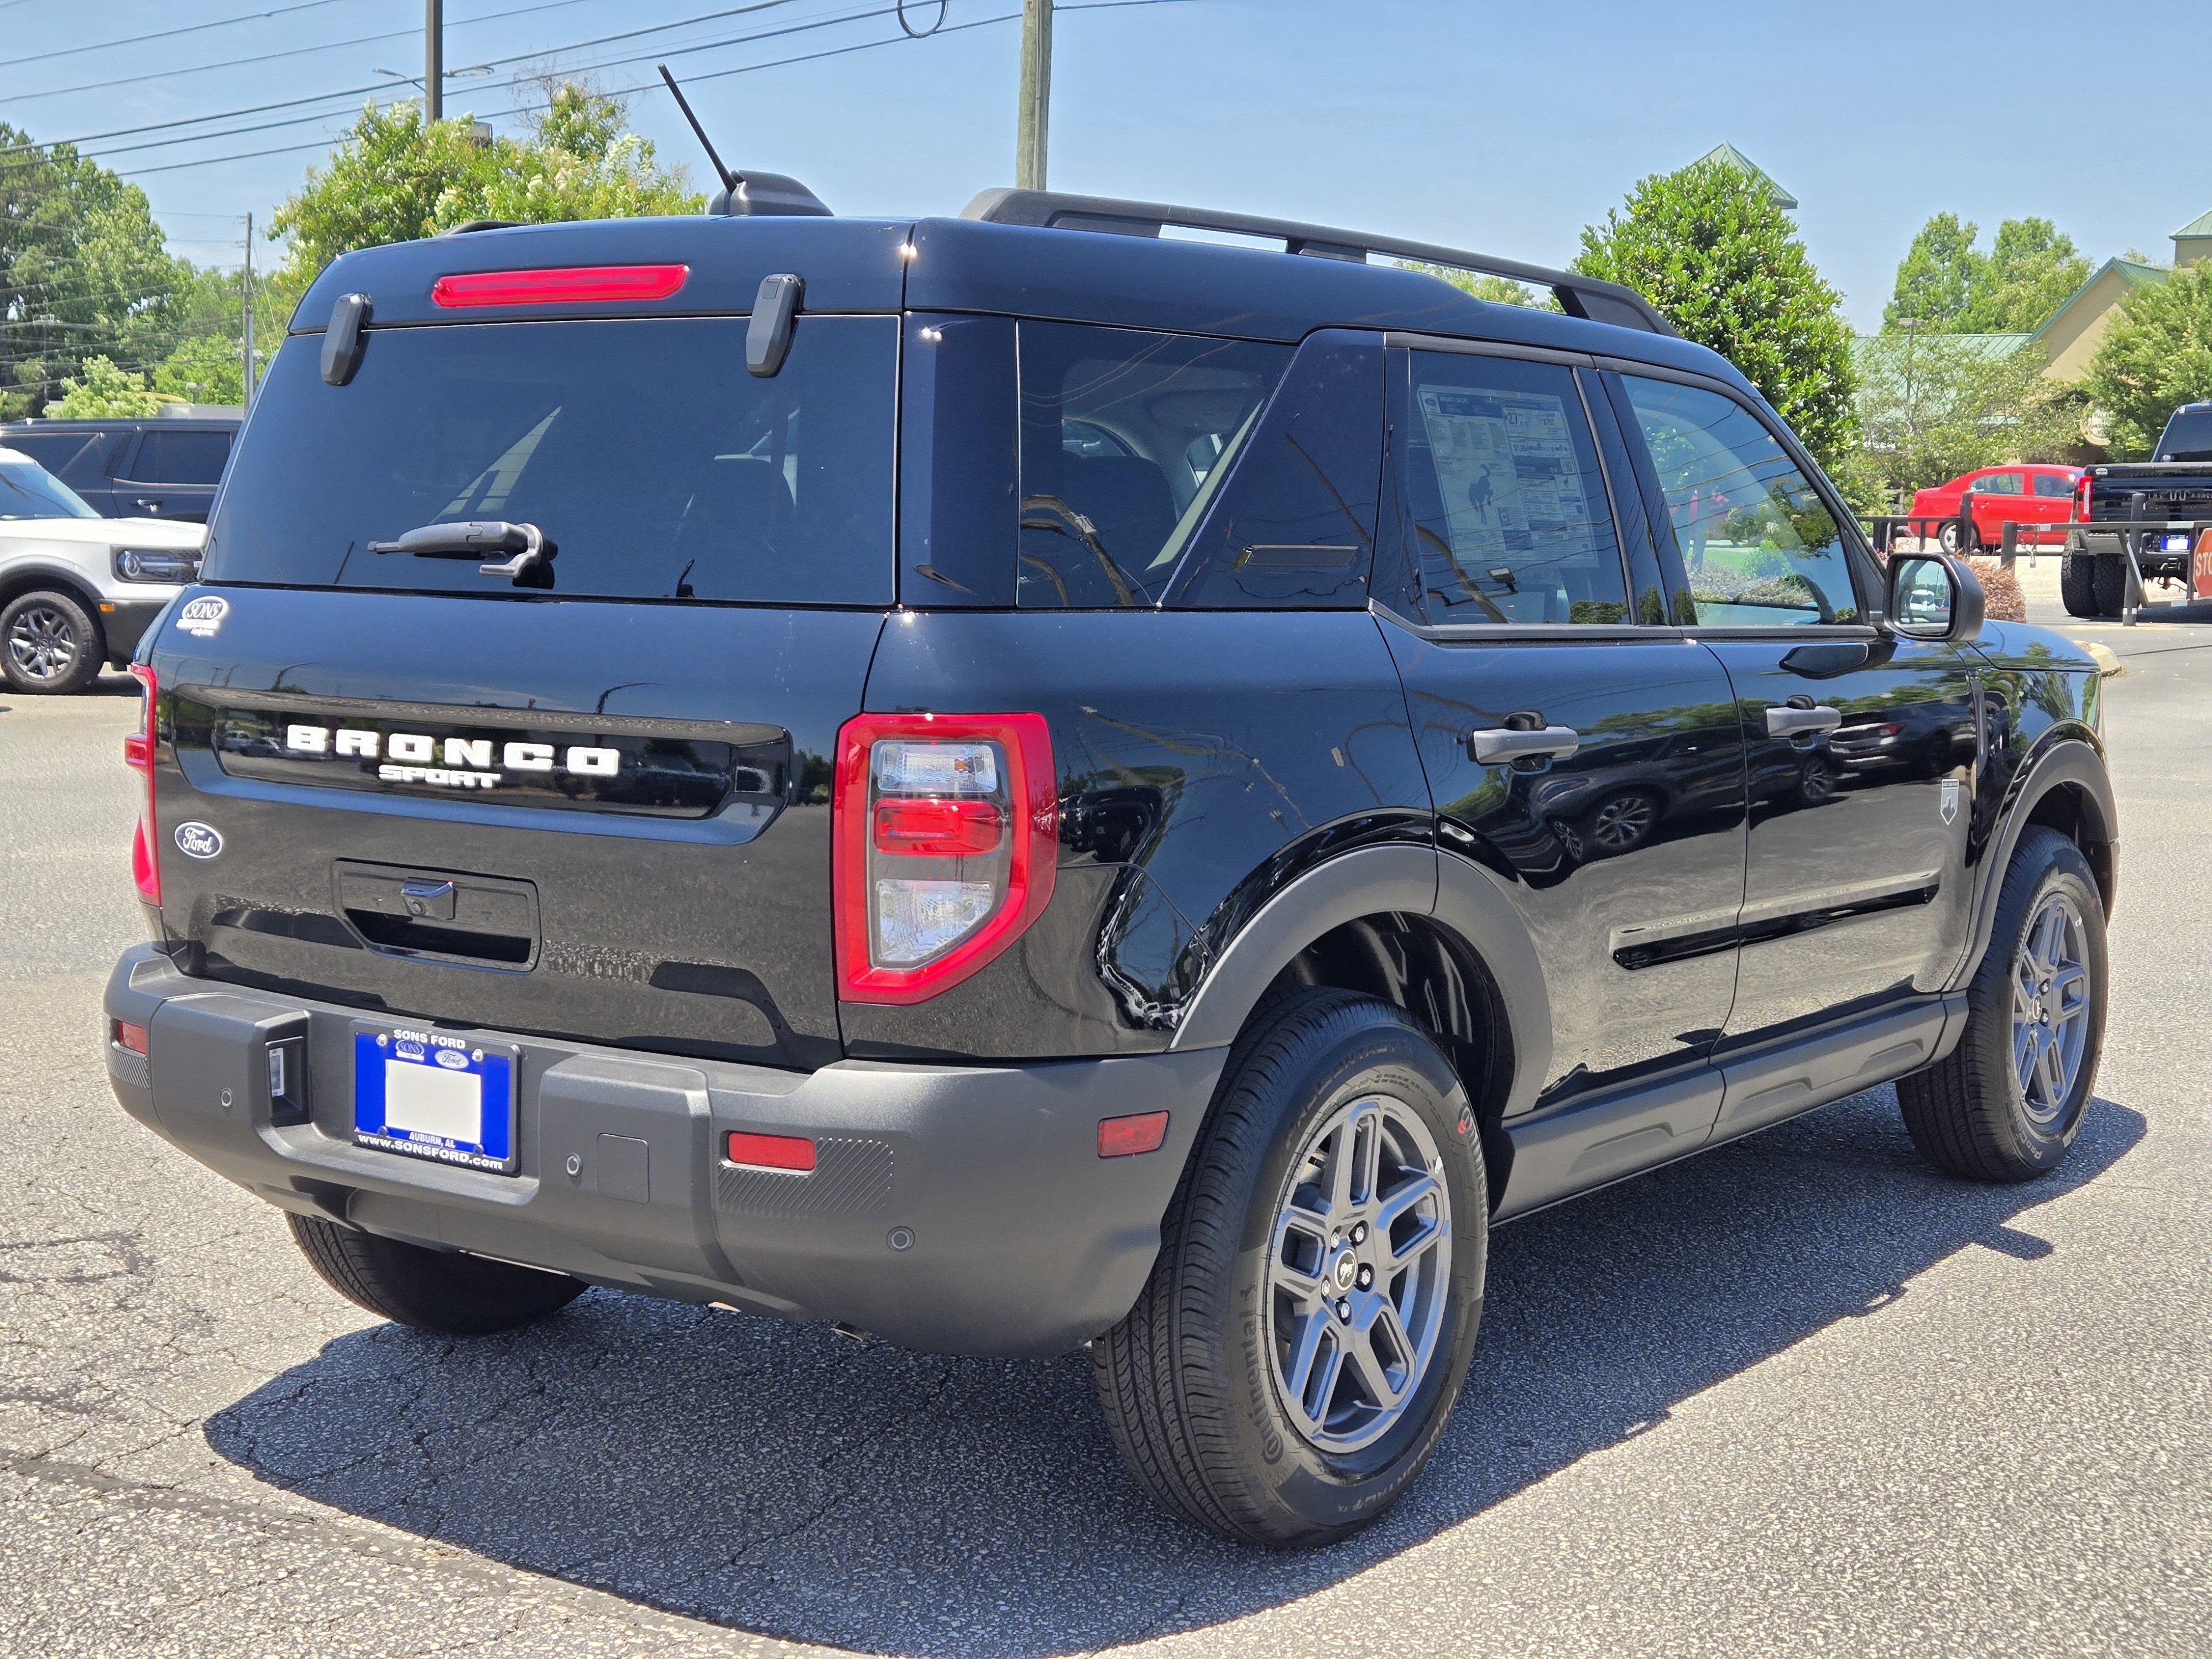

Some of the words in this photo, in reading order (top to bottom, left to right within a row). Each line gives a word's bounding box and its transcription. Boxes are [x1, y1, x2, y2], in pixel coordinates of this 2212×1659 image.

[186, 602, 221, 619] SONS
[286, 724, 620, 777] BRONCO
[378, 765, 502, 788] SPORT
[182, 827, 213, 854] Ford
[393, 1029, 428, 1043] SONS
[430, 1035, 466, 1049] FORD
[399, 1042, 421, 1054] SONS
[441, 1052, 461, 1065] Ford
[408, 1131, 443, 1147] AUBURN,
[445, 1139, 456, 1149] AL
[358, 1134, 503, 1170] www.SONSFORD.com
[1239, 1307, 1285, 1465] Continental
